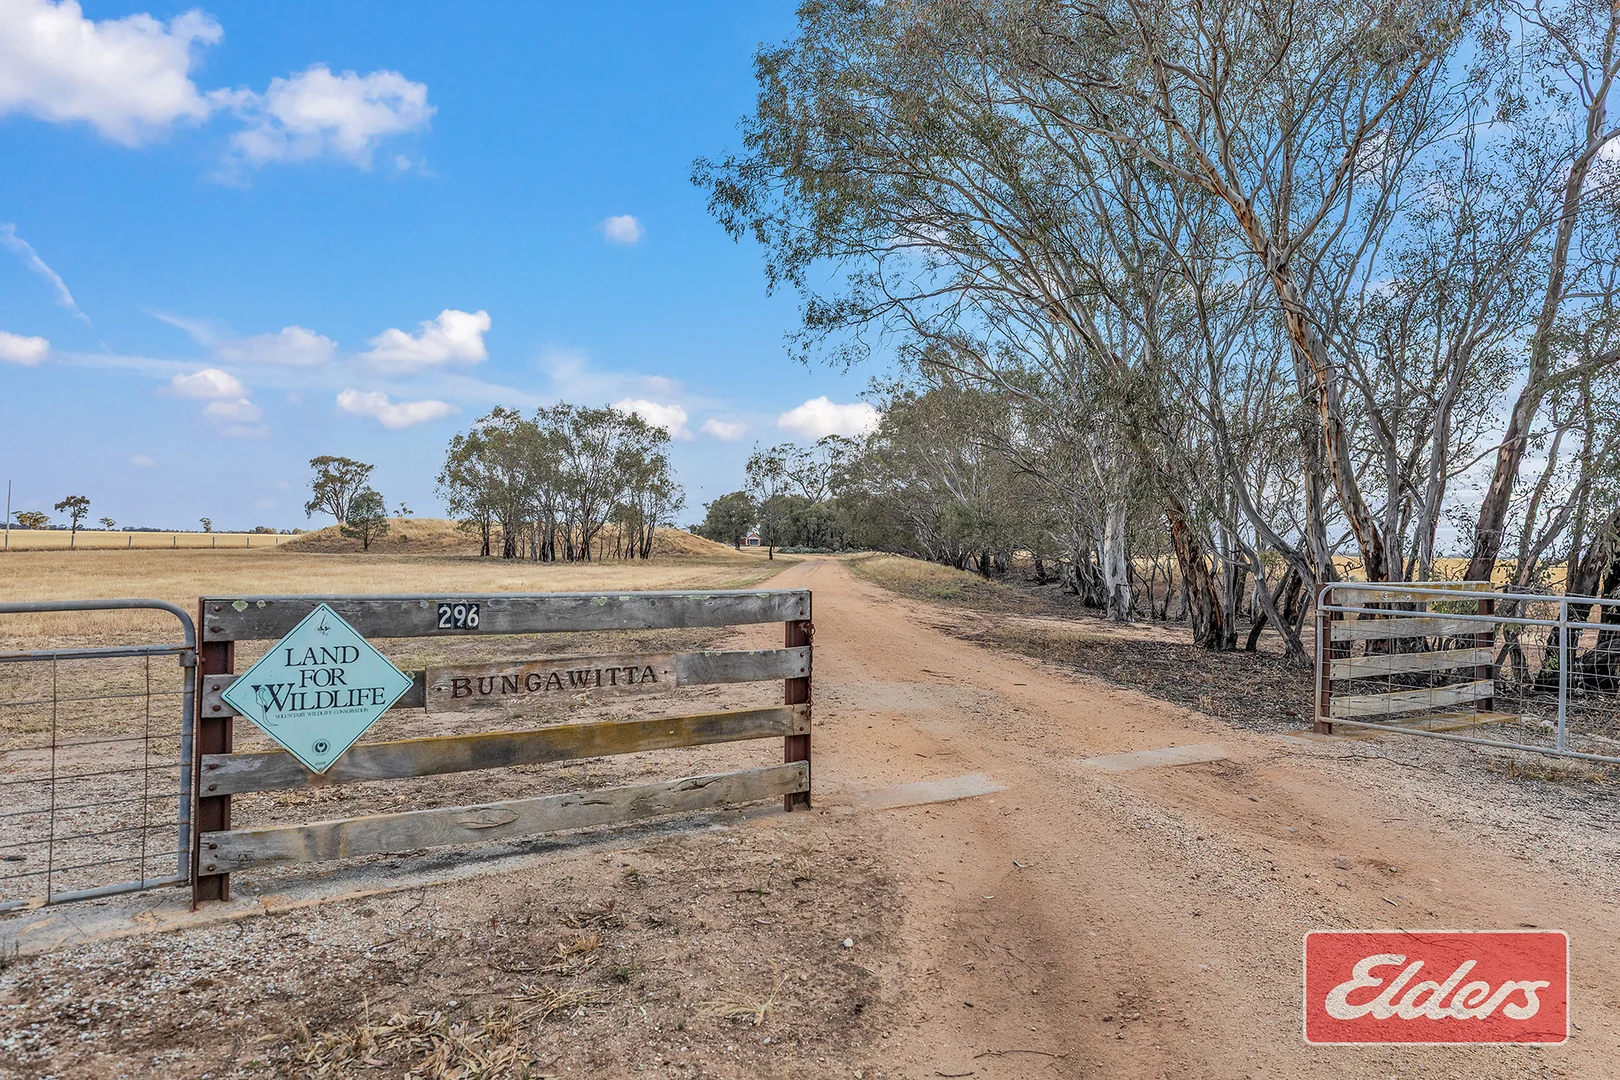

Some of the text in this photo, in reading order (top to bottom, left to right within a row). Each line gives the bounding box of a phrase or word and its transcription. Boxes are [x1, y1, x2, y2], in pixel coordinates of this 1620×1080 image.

[438, 604, 479, 628] 296
[286, 645, 359, 667] LAND
[299, 668, 347, 688] FOR
[451, 665, 657, 698] BUNGAWITTA
[251, 683, 386, 713] WILDLIFE
[275, 711, 306, 719] VOLUNTARY
